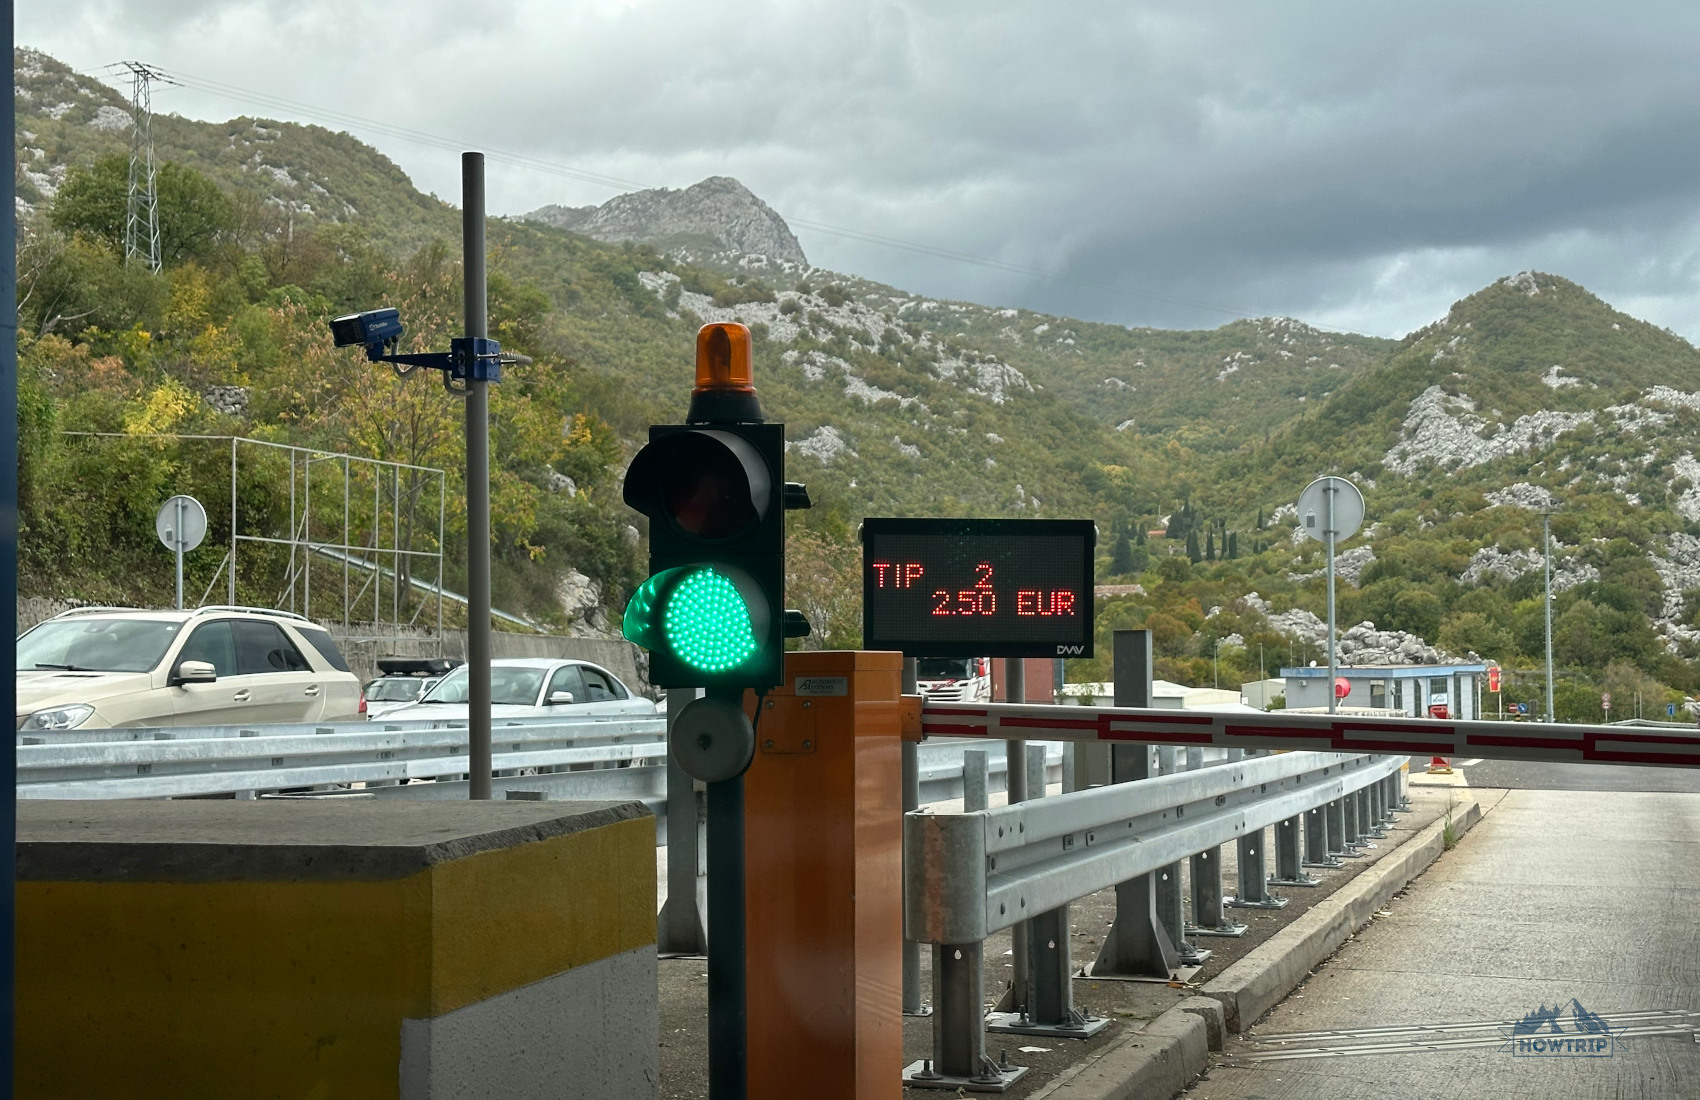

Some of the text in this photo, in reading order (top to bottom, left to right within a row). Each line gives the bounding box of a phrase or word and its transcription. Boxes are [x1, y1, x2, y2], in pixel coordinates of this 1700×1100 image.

[872, 562, 993, 589] TIP 2
[931, 590, 1075, 616] 2.50 EUR
